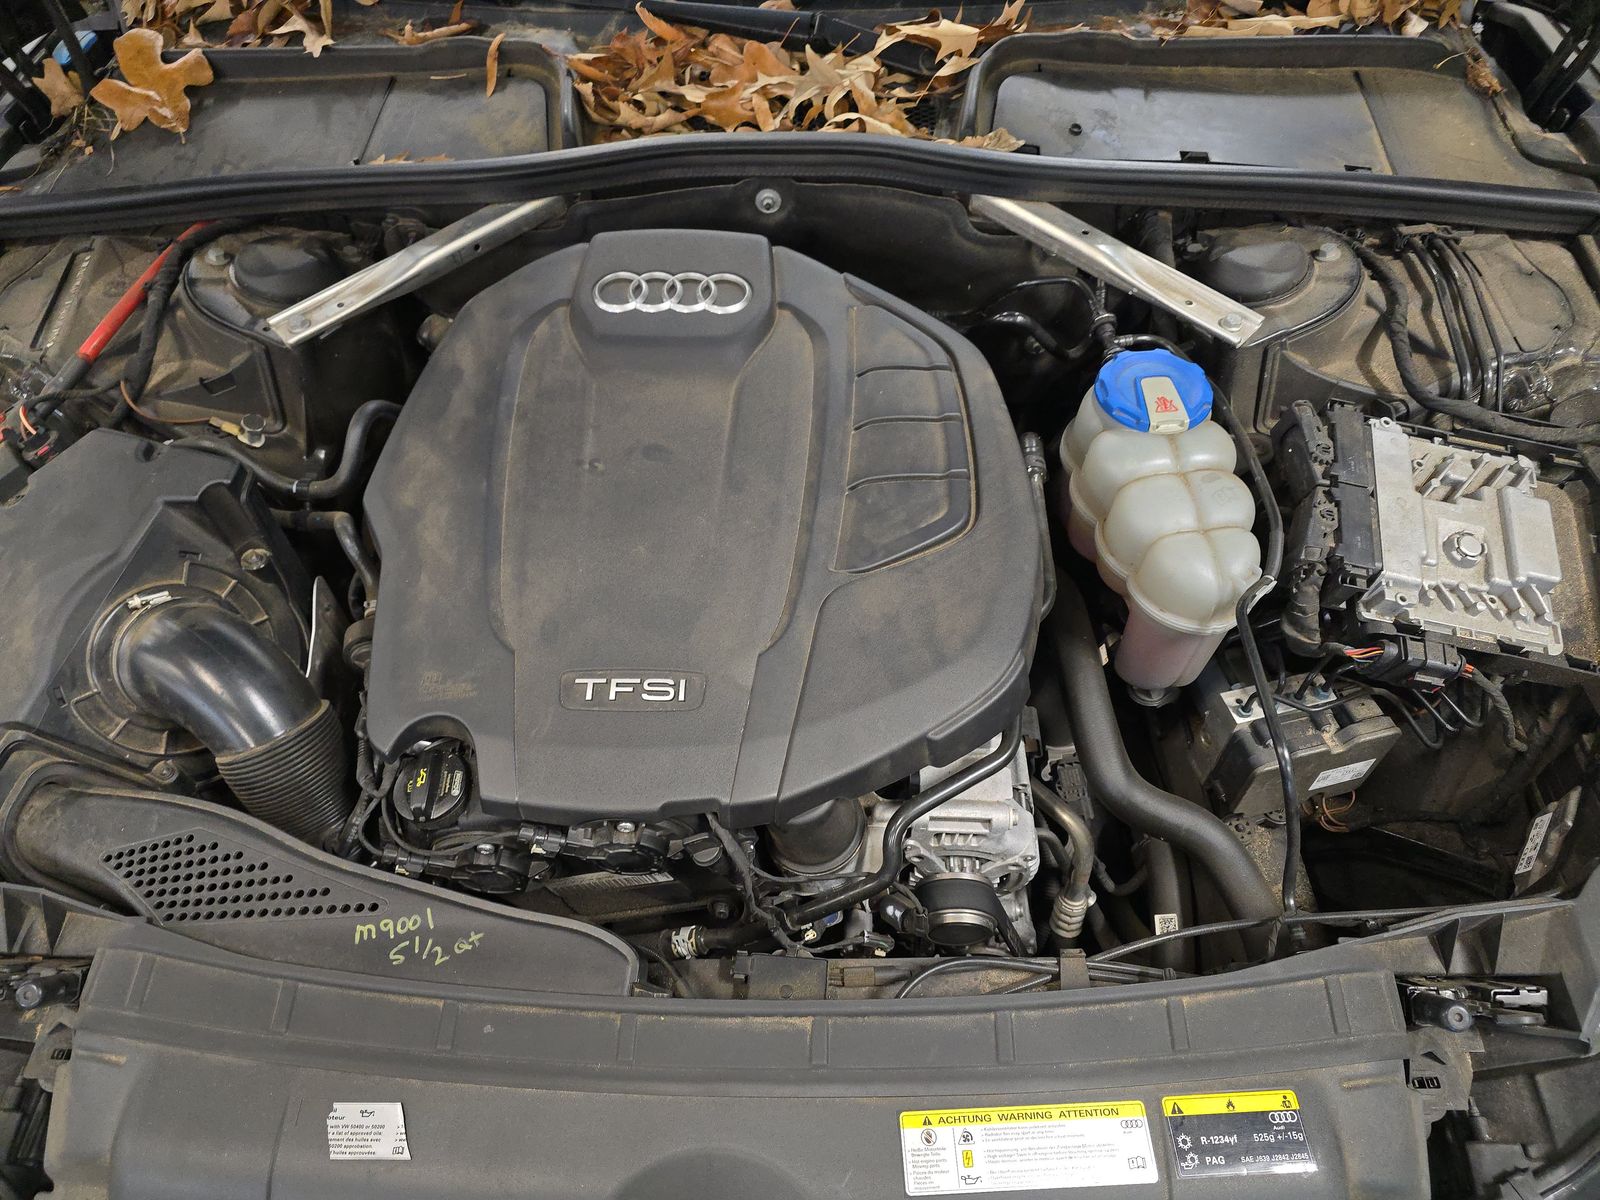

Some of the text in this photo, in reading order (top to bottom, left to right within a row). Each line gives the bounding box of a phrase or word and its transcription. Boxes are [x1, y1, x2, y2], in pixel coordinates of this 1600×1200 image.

[574, 678, 687, 702] TFSI
[389, 940, 410, 965] 5
[937, 1107, 1120, 1125] ACHTUNG WARNING ATTENTION
[1200, 1131, 1304, 1146] R-1234yf 525g +/-15g
[1205, 1155, 1226, 1165] PAG
[1240, 1155, 1255, 1163] SAE
